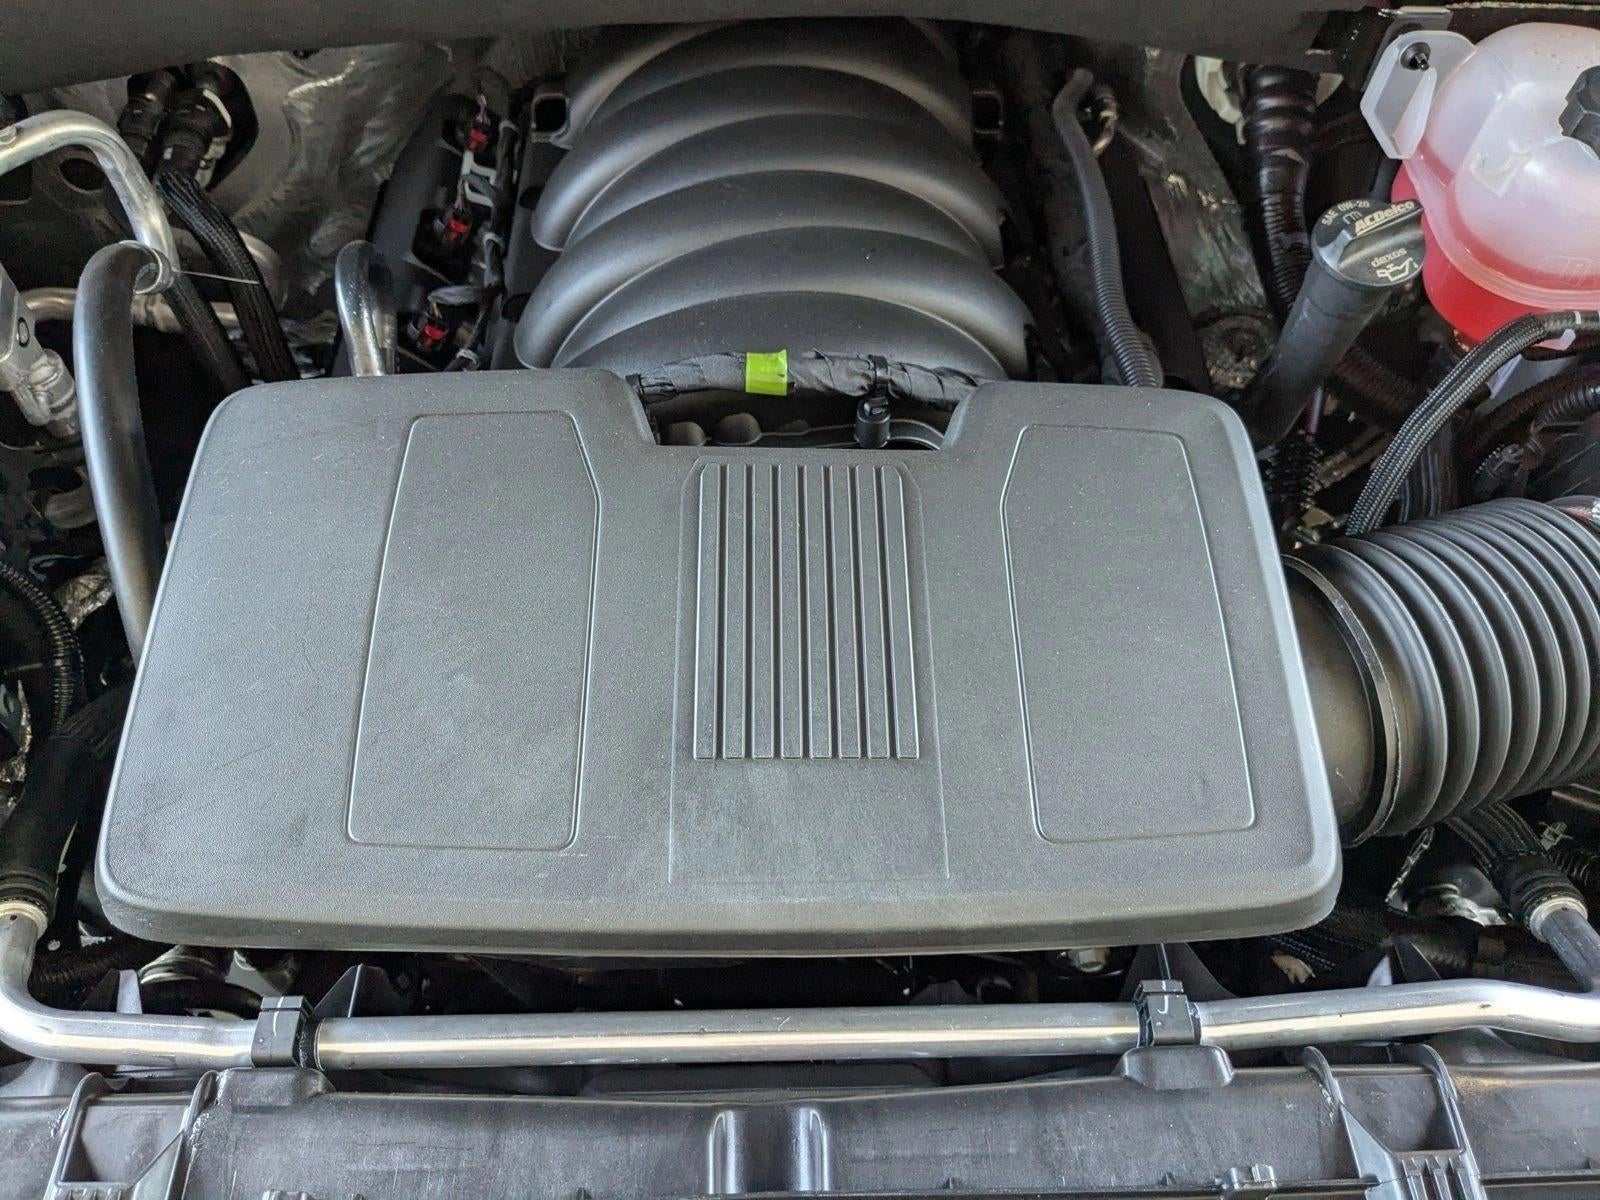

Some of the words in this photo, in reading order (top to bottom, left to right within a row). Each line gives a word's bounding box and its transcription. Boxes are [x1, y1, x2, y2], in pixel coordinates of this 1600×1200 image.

[1321, 209, 1339, 226] SAE
[1337, 200, 1370, 212] 0W-20
[1355, 201, 1415, 233] ACDelco
[1371, 247, 1408, 268] dexos
